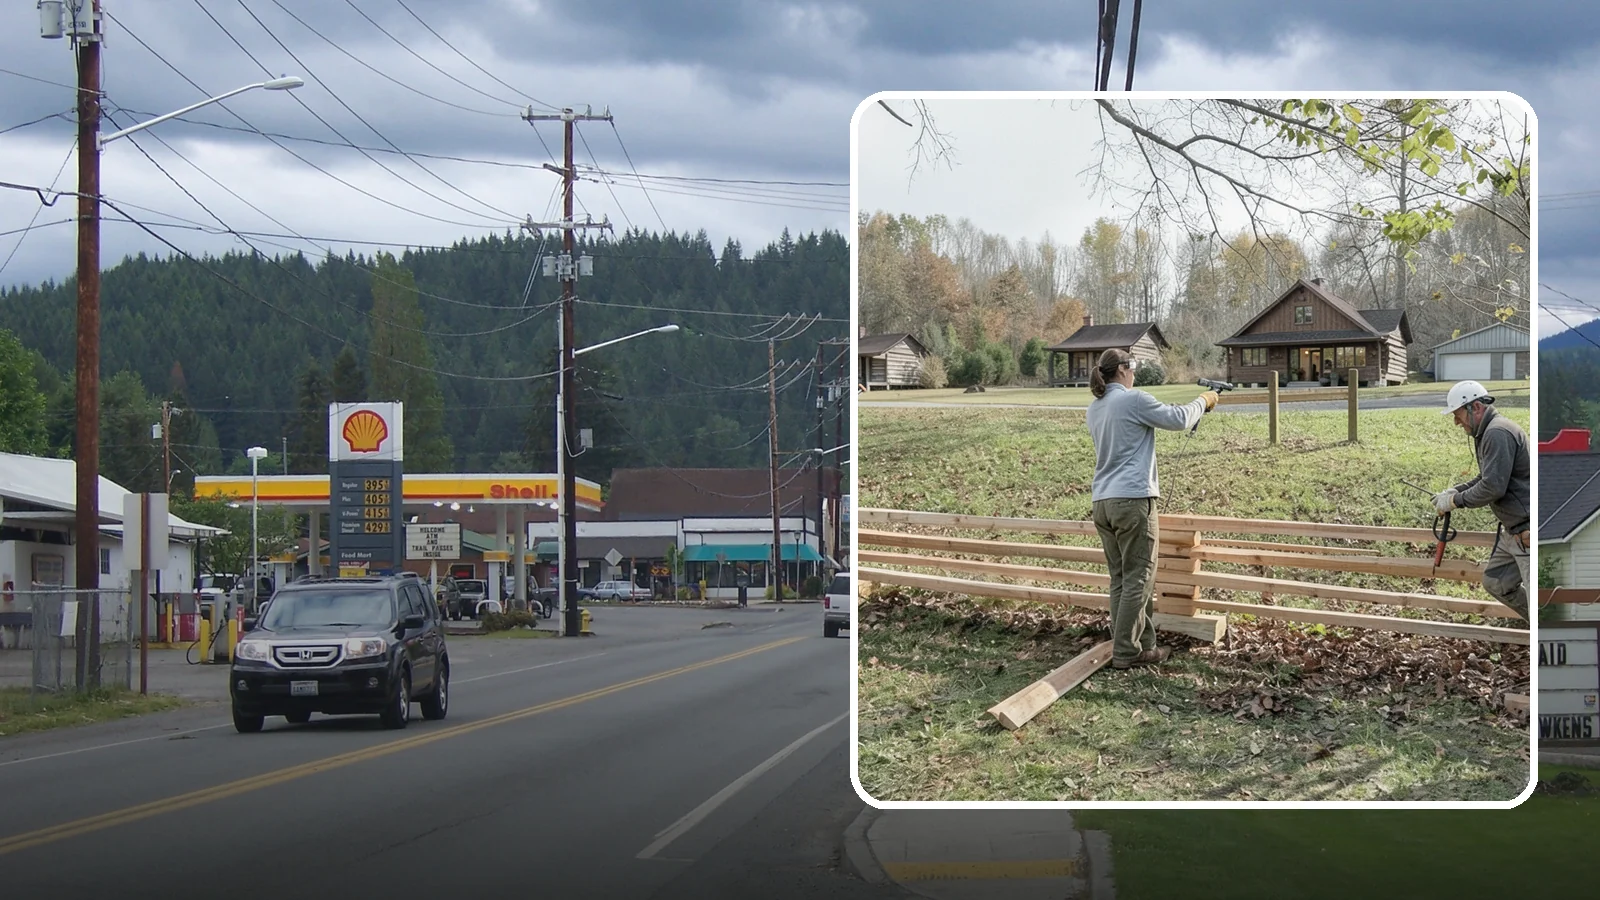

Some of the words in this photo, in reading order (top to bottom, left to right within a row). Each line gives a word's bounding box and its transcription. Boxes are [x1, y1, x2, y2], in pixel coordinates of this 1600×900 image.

[366, 480, 384, 490] 395
[490, 484, 547, 499] Shell
[366, 494, 384, 504] 405
[366, 508, 383, 518] 415
[366, 522, 384, 533] 429
